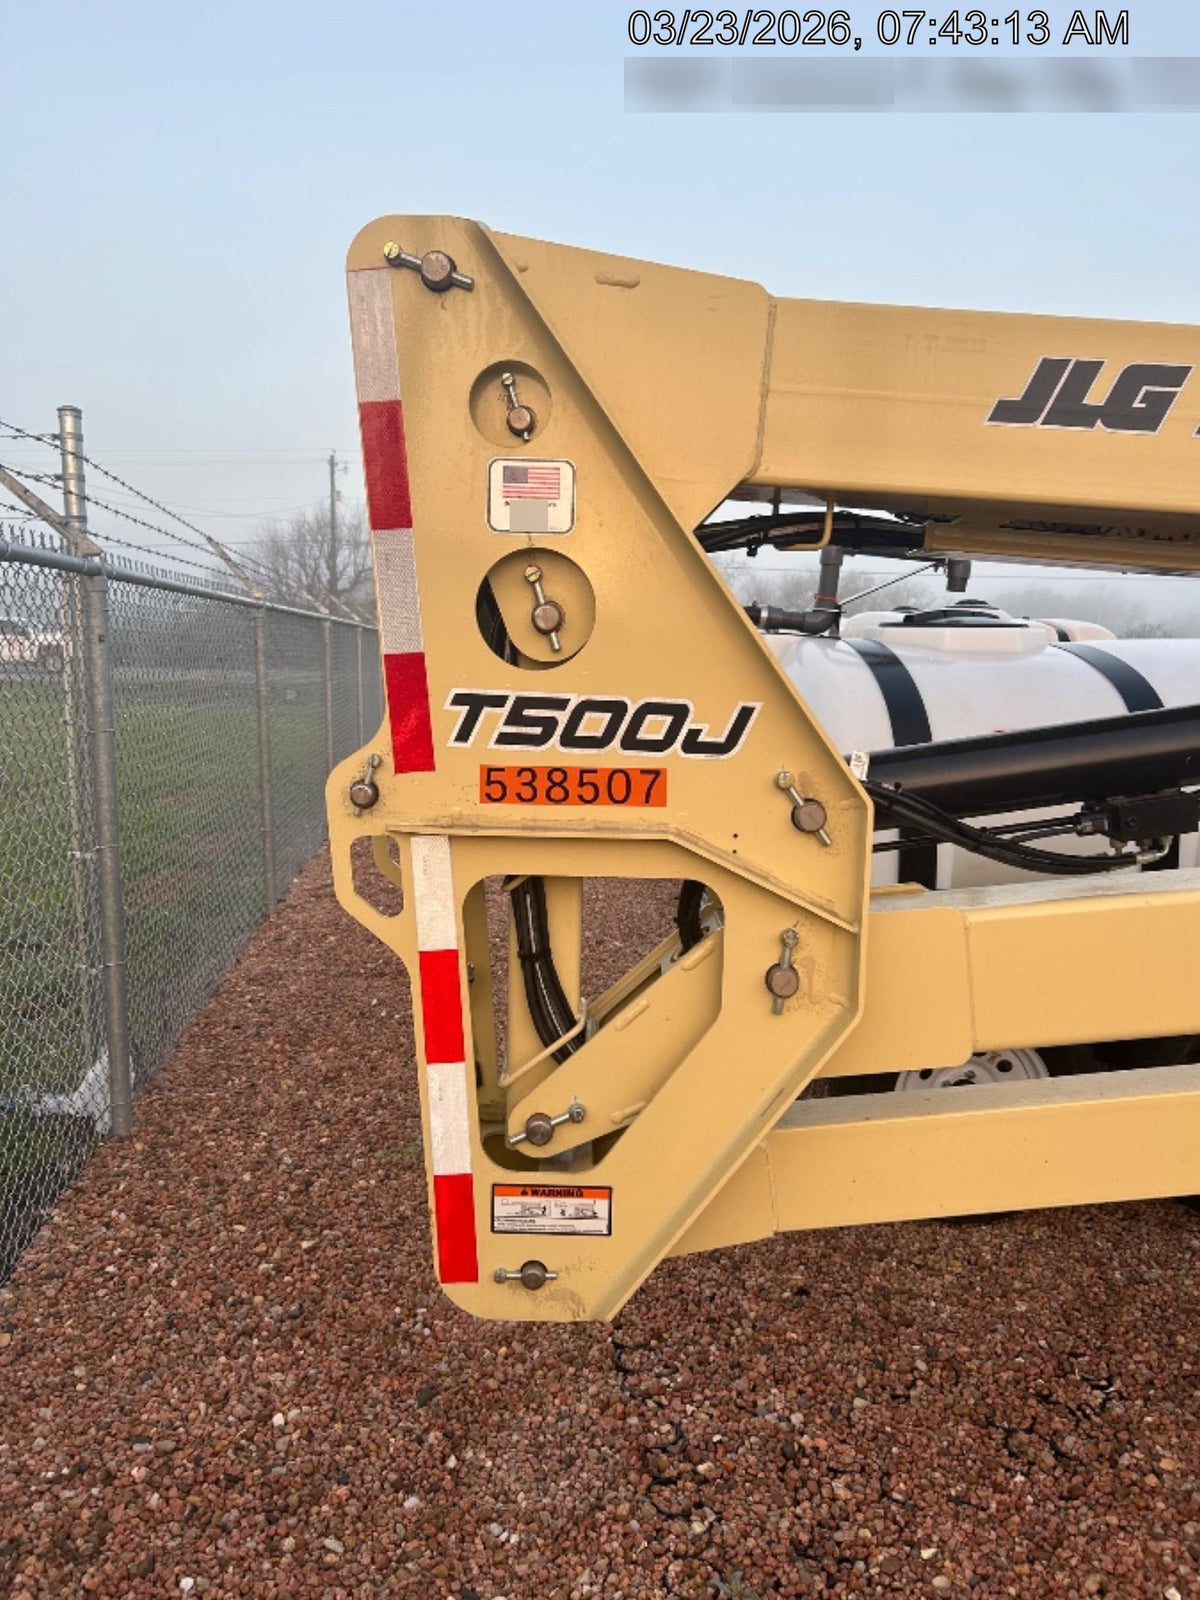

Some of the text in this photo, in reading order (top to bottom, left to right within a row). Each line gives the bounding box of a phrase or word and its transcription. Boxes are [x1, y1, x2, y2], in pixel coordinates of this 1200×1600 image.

[984, 356, 1194, 434] JLG
[444, 689, 762, 759] T500J
[484, 767, 662, 805] 538507
[531, 1188, 584, 1198] WARNING
